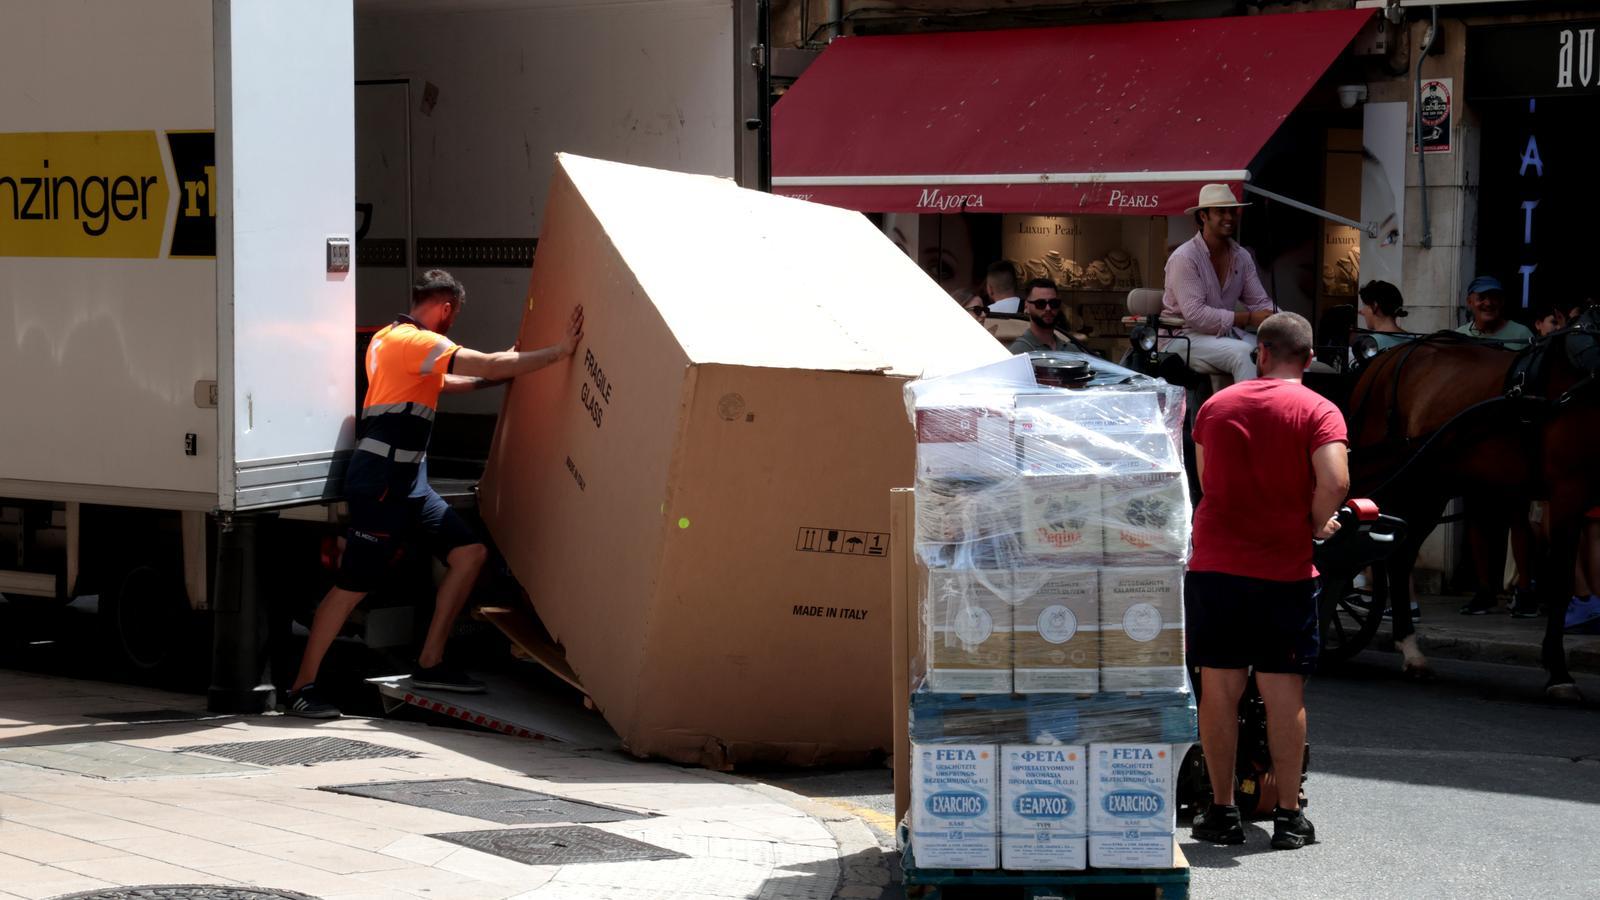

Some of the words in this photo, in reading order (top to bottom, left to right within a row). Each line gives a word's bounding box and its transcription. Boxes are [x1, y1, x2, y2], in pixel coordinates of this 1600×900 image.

[916, 188, 984, 210] MAJORCA
[1108, 189, 1159, 208] PEARLS
[1018, 222, 1050, 237] Luxury
[584, 347, 612, 405] FRAGILE
[581, 382, 603, 429] GLASS
[792, 605, 824, 617] MADE
[826, 607, 837, 618] IN
[840, 608, 868, 620] ITALY
[936, 749, 977, 761] FETA
[1021, 750, 1066, 762] ΦΕΤΑ
[1112, 748, 1153, 760] FETA
[933, 796, 982, 813] EXARCHOS
[1019, 797, 1068, 814] ΕΞΑΡΧΟΣ
[1108, 795, 1158, 812] EXARCHOS
